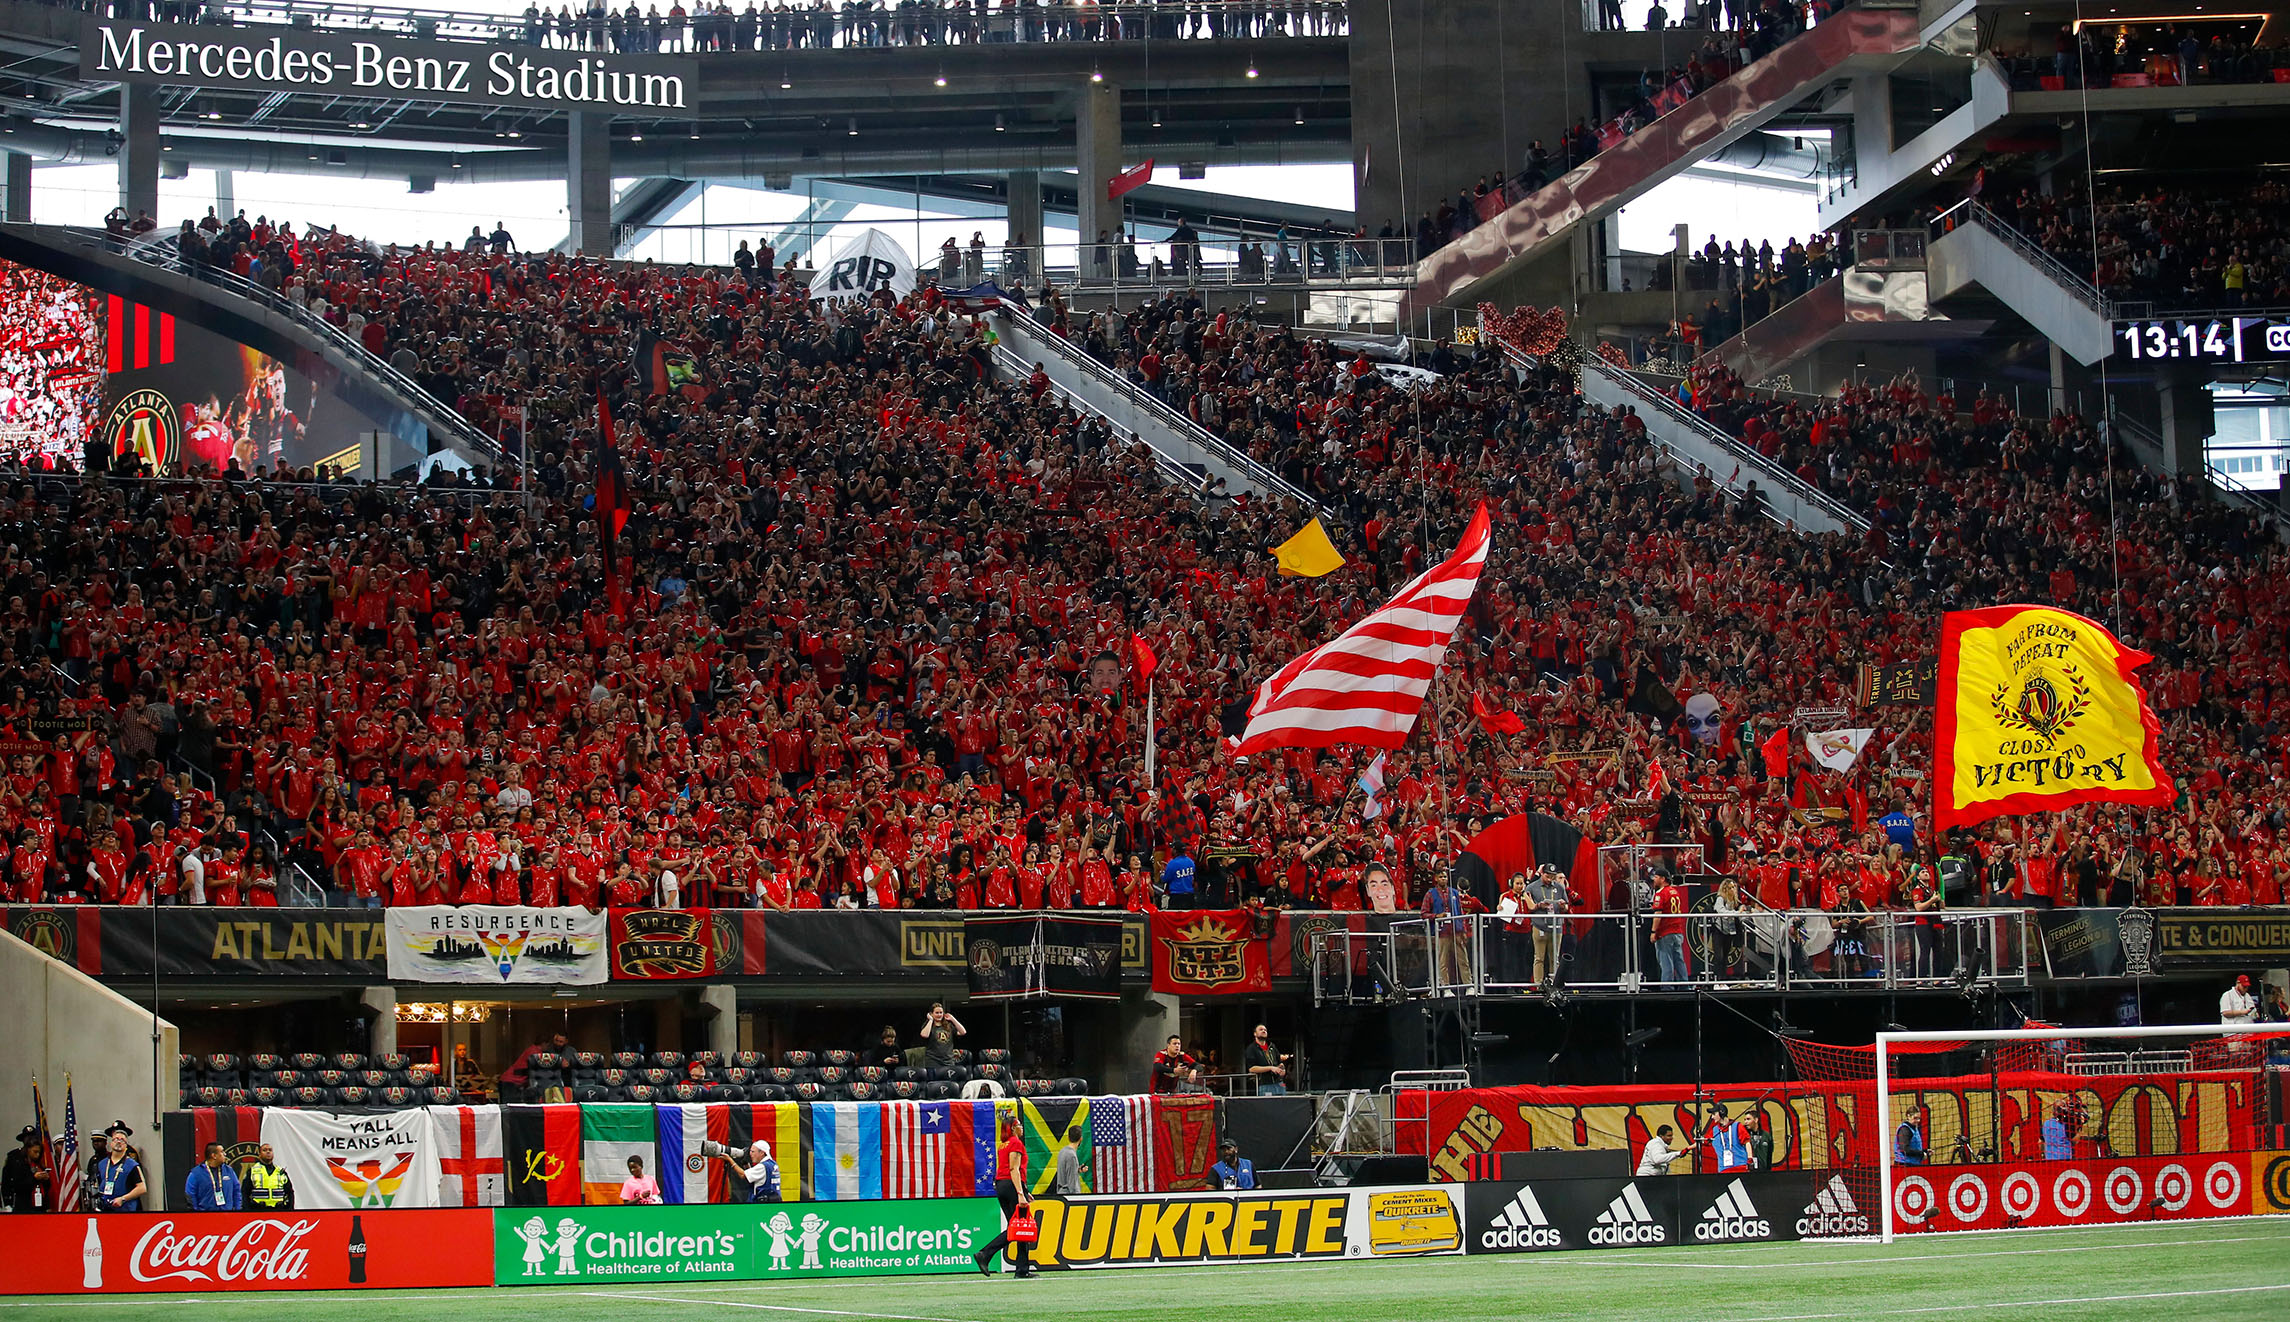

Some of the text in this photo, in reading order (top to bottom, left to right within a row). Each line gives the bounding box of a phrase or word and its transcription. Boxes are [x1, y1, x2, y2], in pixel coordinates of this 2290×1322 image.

[95, 26, 687, 110] Mercedes-Benz Stadium
[829, 255, 896, 292] RIP
[2125, 325, 2226, 359] 13:14
[114, 393, 168, 425] ATLANTA
[507, 406, 520, 415] 136
[2005, 622, 2077, 659] FAR FROM
[2012, 642, 2070, 675] DEFEAT
[1869, 665, 1881, 705] TERMINUS
[33, 721, 65, 729] FOOTIE
[67, 720, 86, 728] MOB
[25, 742, 43, 750] MOB
[2061, 743, 2086, 760] TO
[1973, 752, 2127, 788] VICTORY
[23, 914, 62, 927] ATLANTA
[431, 915, 575, 931] RESURGENCE
[640, 917, 679, 928] HAIL
[2050, 918, 2089, 942] TERMINUS
[211, 921, 387, 961] ATLANTA
[630, 945, 693, 957] UNITED
[2063, 935, 2094, 952] LEGION
[1177, 946, 1238, 963] ATL
[1177, 963, 1241, 977] UTD
[351, 1120, 394, 1134] Y'ALL
[321, 1133, 418, 1150] MEANS ALL.
[1161, 1109, 1214, 1176] 17
[1383, 1205, 1440, 1217] QUIKRETE
[1006, 1198, 1347, 1266] QUIKRETE
[1481, 1223, 1562, 1249] adidas
[1587, 1220, 1666, 1245] adidas
[1693, 1216, 1772, 1241] adidas
[1795, 1212, 1870, 1236] adidas
[129, 1218, 321, 1282] Coca-Cola
[585, 1229, 736, 1258] Children's
[828, 1224, 973, 1253] Children's
[586, 1260, 735, 1275] Healthcare of Atlanta
[829, 1254, 973, 1269] Healthcare of Atlanta
